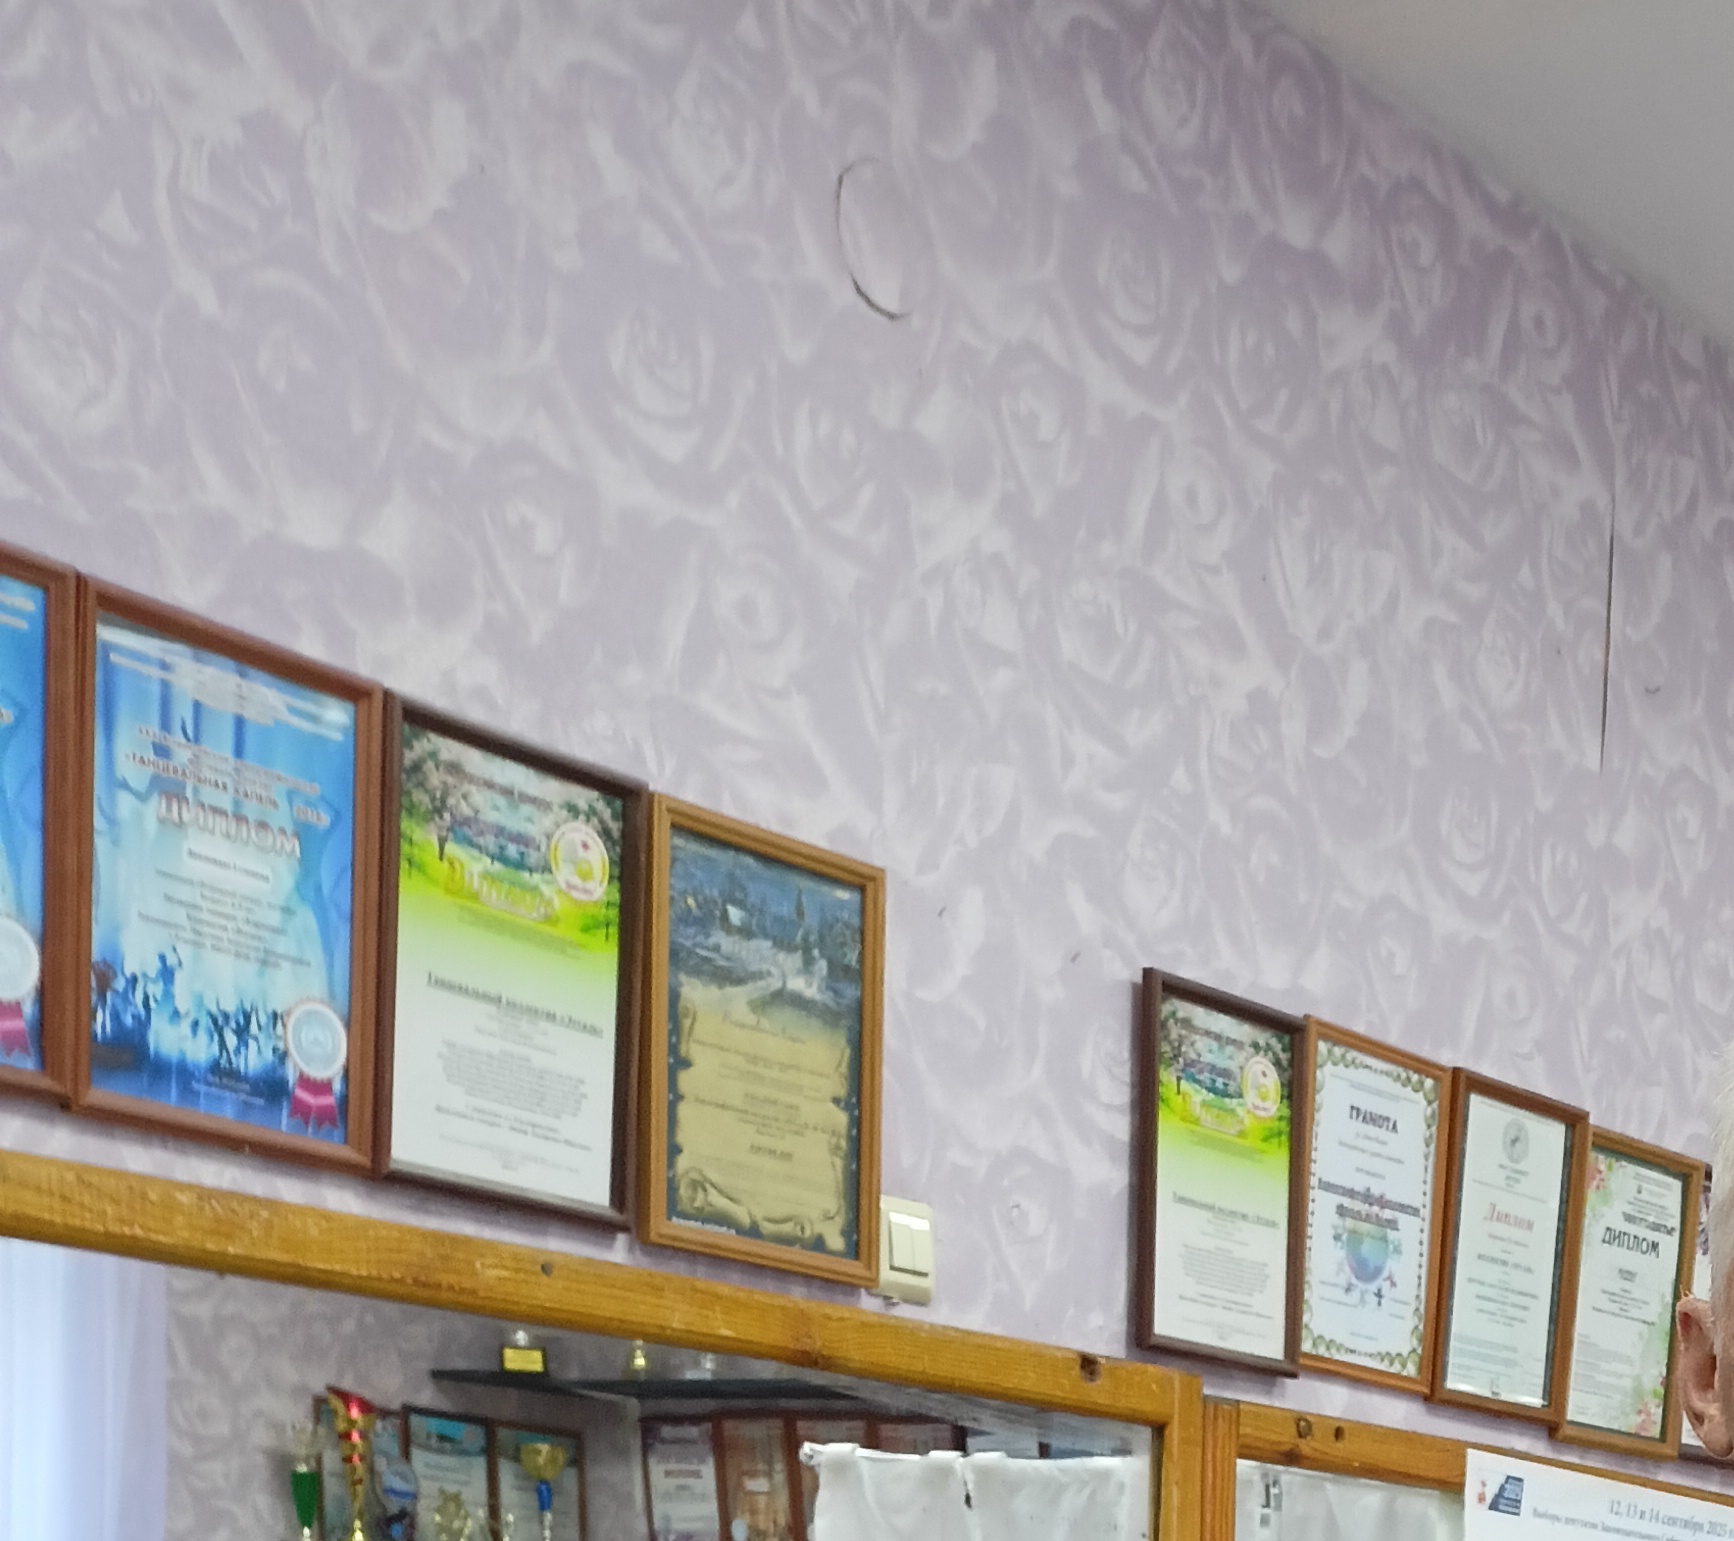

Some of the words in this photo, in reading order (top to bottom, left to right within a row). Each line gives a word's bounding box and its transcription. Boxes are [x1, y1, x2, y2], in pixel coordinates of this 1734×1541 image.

[157, 792, 301, 859] ДИПЛОМ
[1349, 1105, 1399, 1134] ГРАМОТА
[1601, 1226, 1660, 1259] ДИПЛОМ
[1625, 1502, 1638, 1520] 13
[1639, 1508, 1647, 1521] и
[1649, 1507, 1660, 1524] 14
[1661, 1514, 1705, 1536] сентября
[1706, 1519, 1728, 1539] 2025
